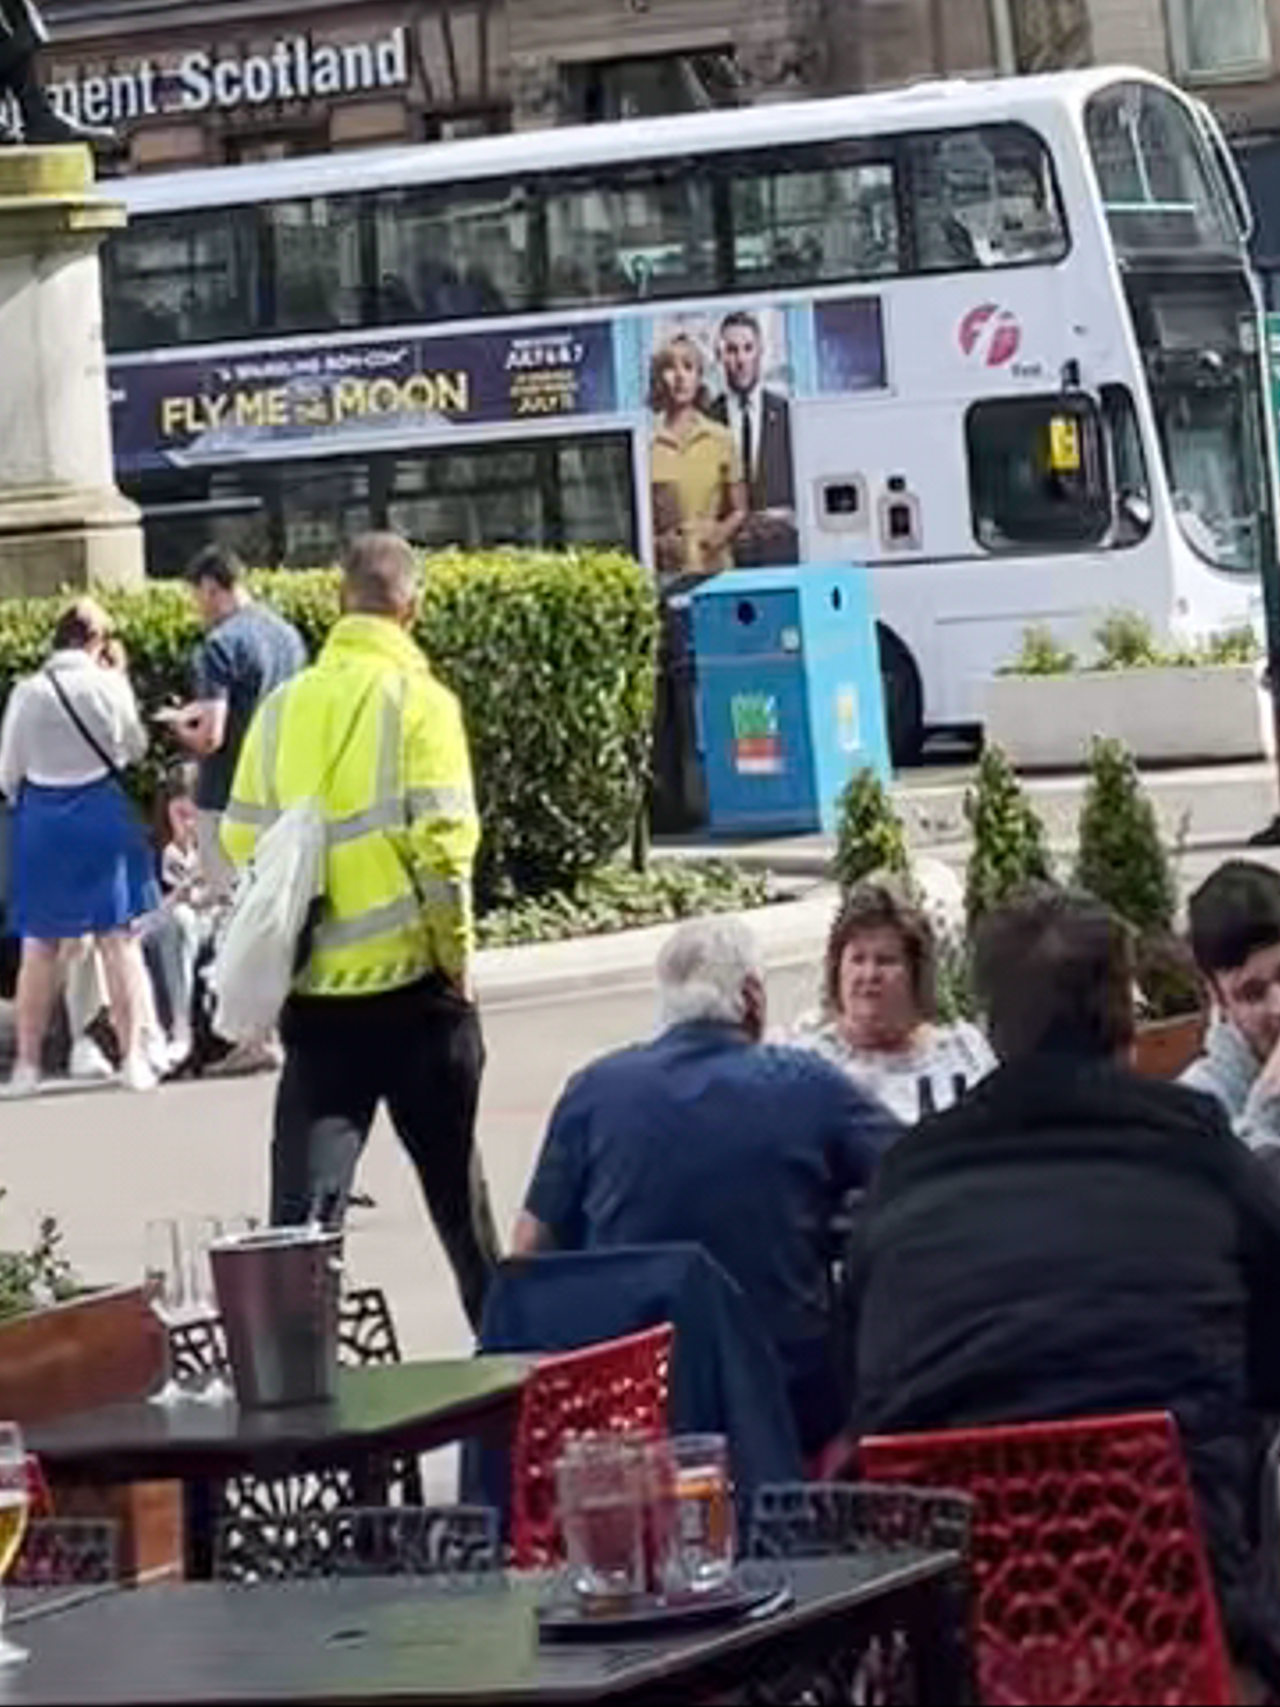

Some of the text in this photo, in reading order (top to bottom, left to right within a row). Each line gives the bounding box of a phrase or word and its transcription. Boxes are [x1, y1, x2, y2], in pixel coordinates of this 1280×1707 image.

[178, 26, 406, 109] Scotland
[161, 392, 228, 433] FLY
[235, 388, 289, 427] ME
[332, 370, 469, 422] MOON
